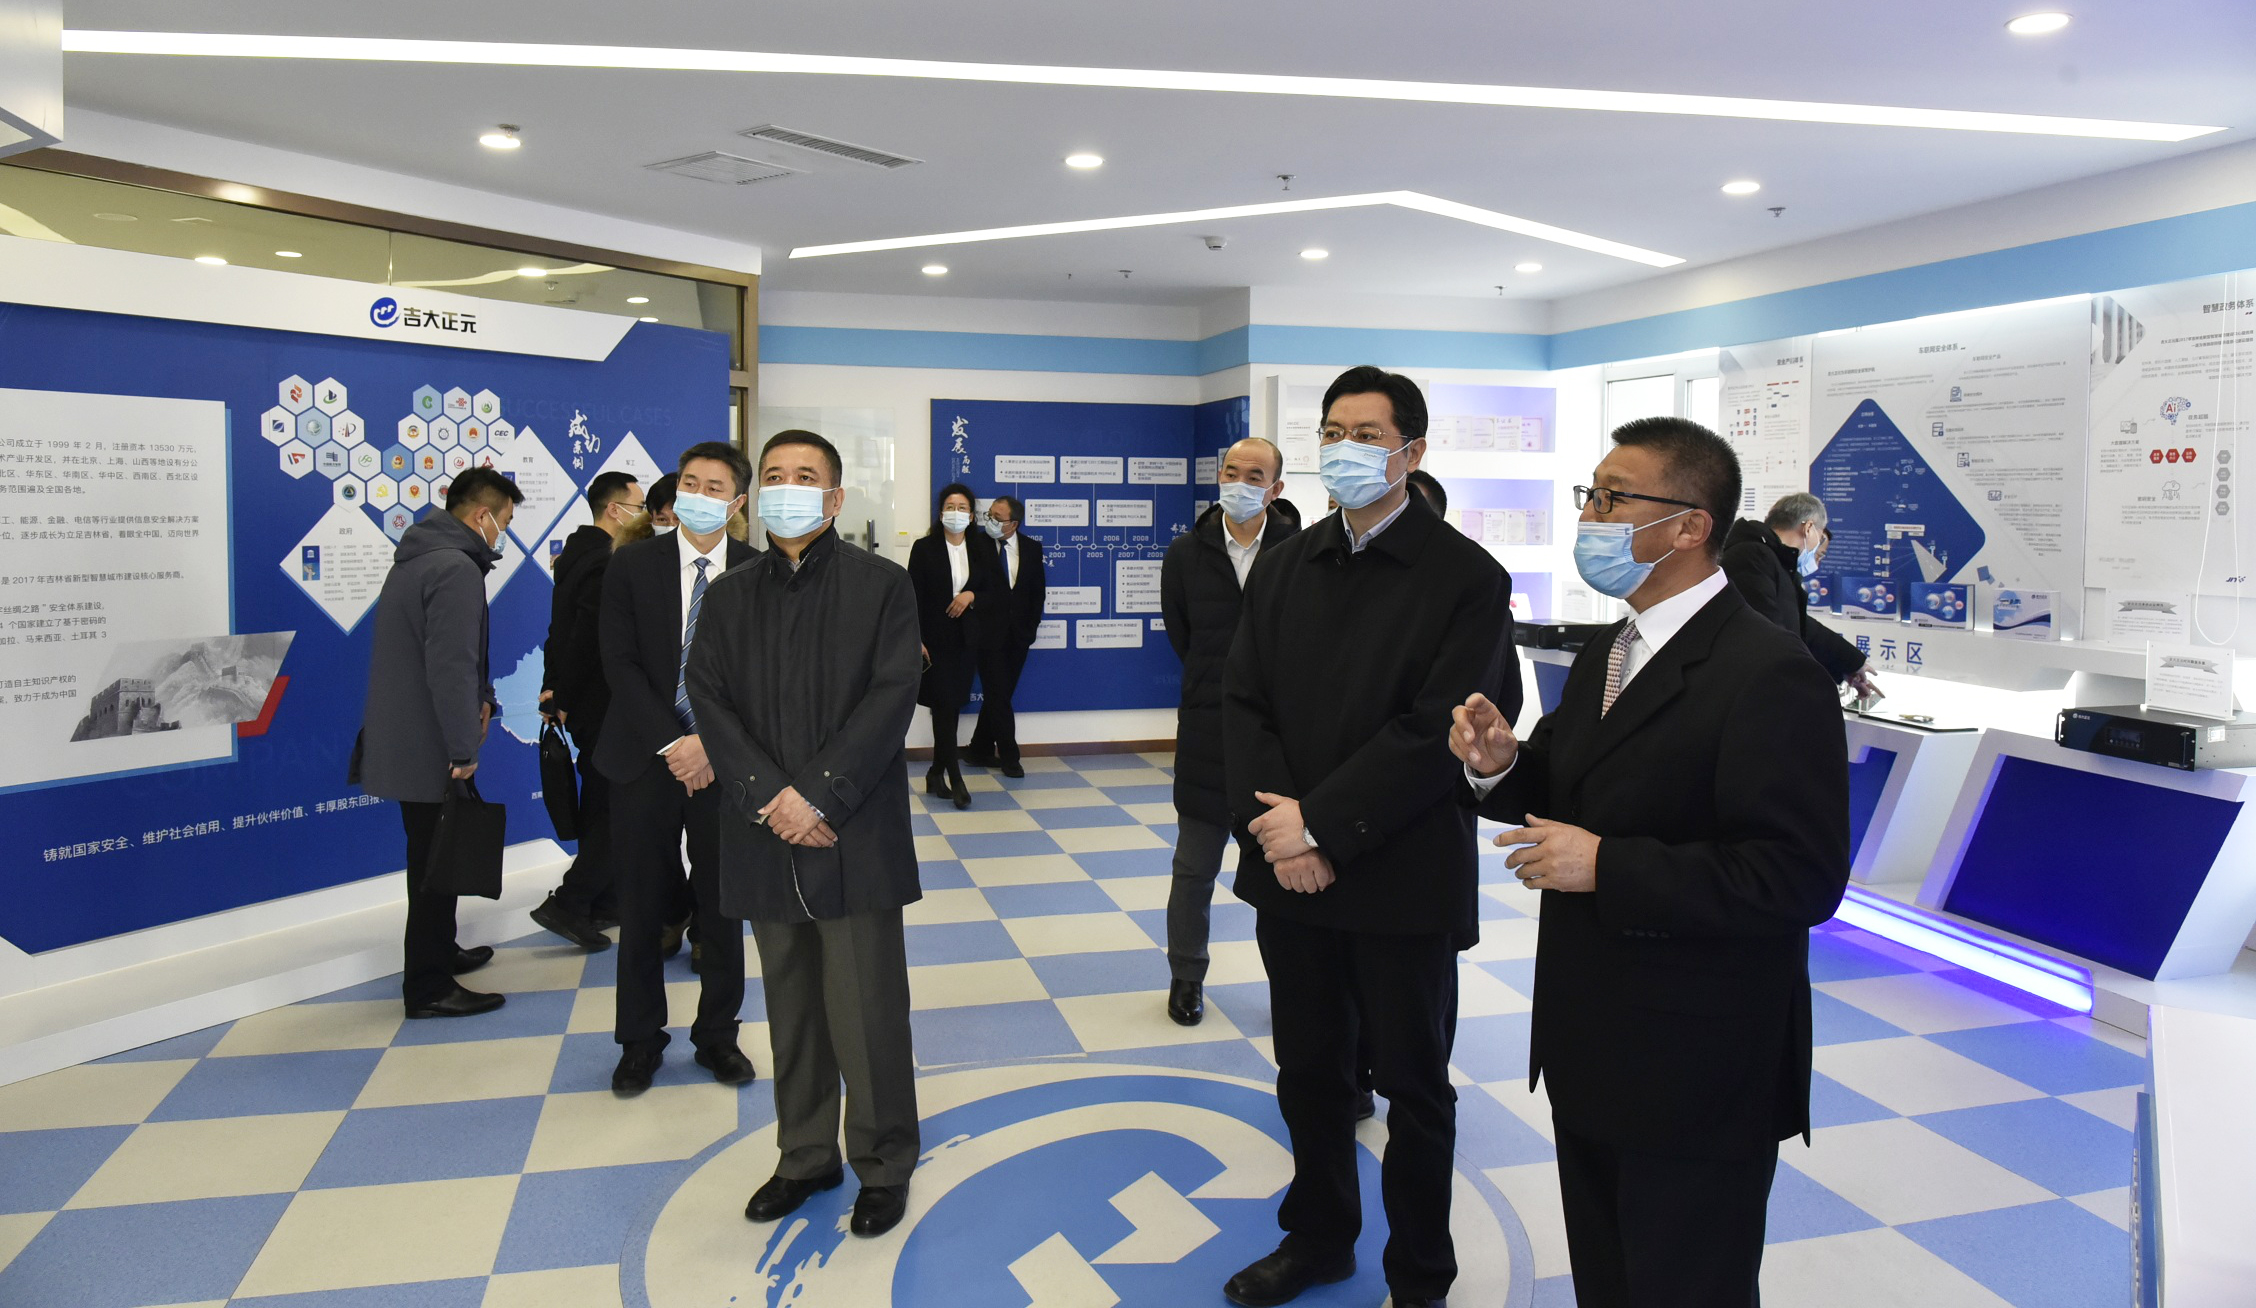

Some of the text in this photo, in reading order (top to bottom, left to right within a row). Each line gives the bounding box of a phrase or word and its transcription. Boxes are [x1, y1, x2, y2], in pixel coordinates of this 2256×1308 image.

[403, 307, 477, 333] 吉大正元
[0, 438, 44, 448] 公司成立于
[47, 440, 70, 449] 1999
[73, 441, 82, 450] 年
[85, 441, 91, 449] 2
[149, 444, 175, 452] 13530
[522, 456, 534, 464] 教育
[625, 459, 636, 467] 军工
[0, 515, 199, 526] 工、能源、金融、电信等行业提供信息安全解决方案
[0, 529, 200, 541] 位，逐步成长为立足吉林省，着眼全中国，迈向世界
[338, 527, 353, 536] 政府
[12, 575, 34, 585] 2017
[101, 631, 107, 639] 3
